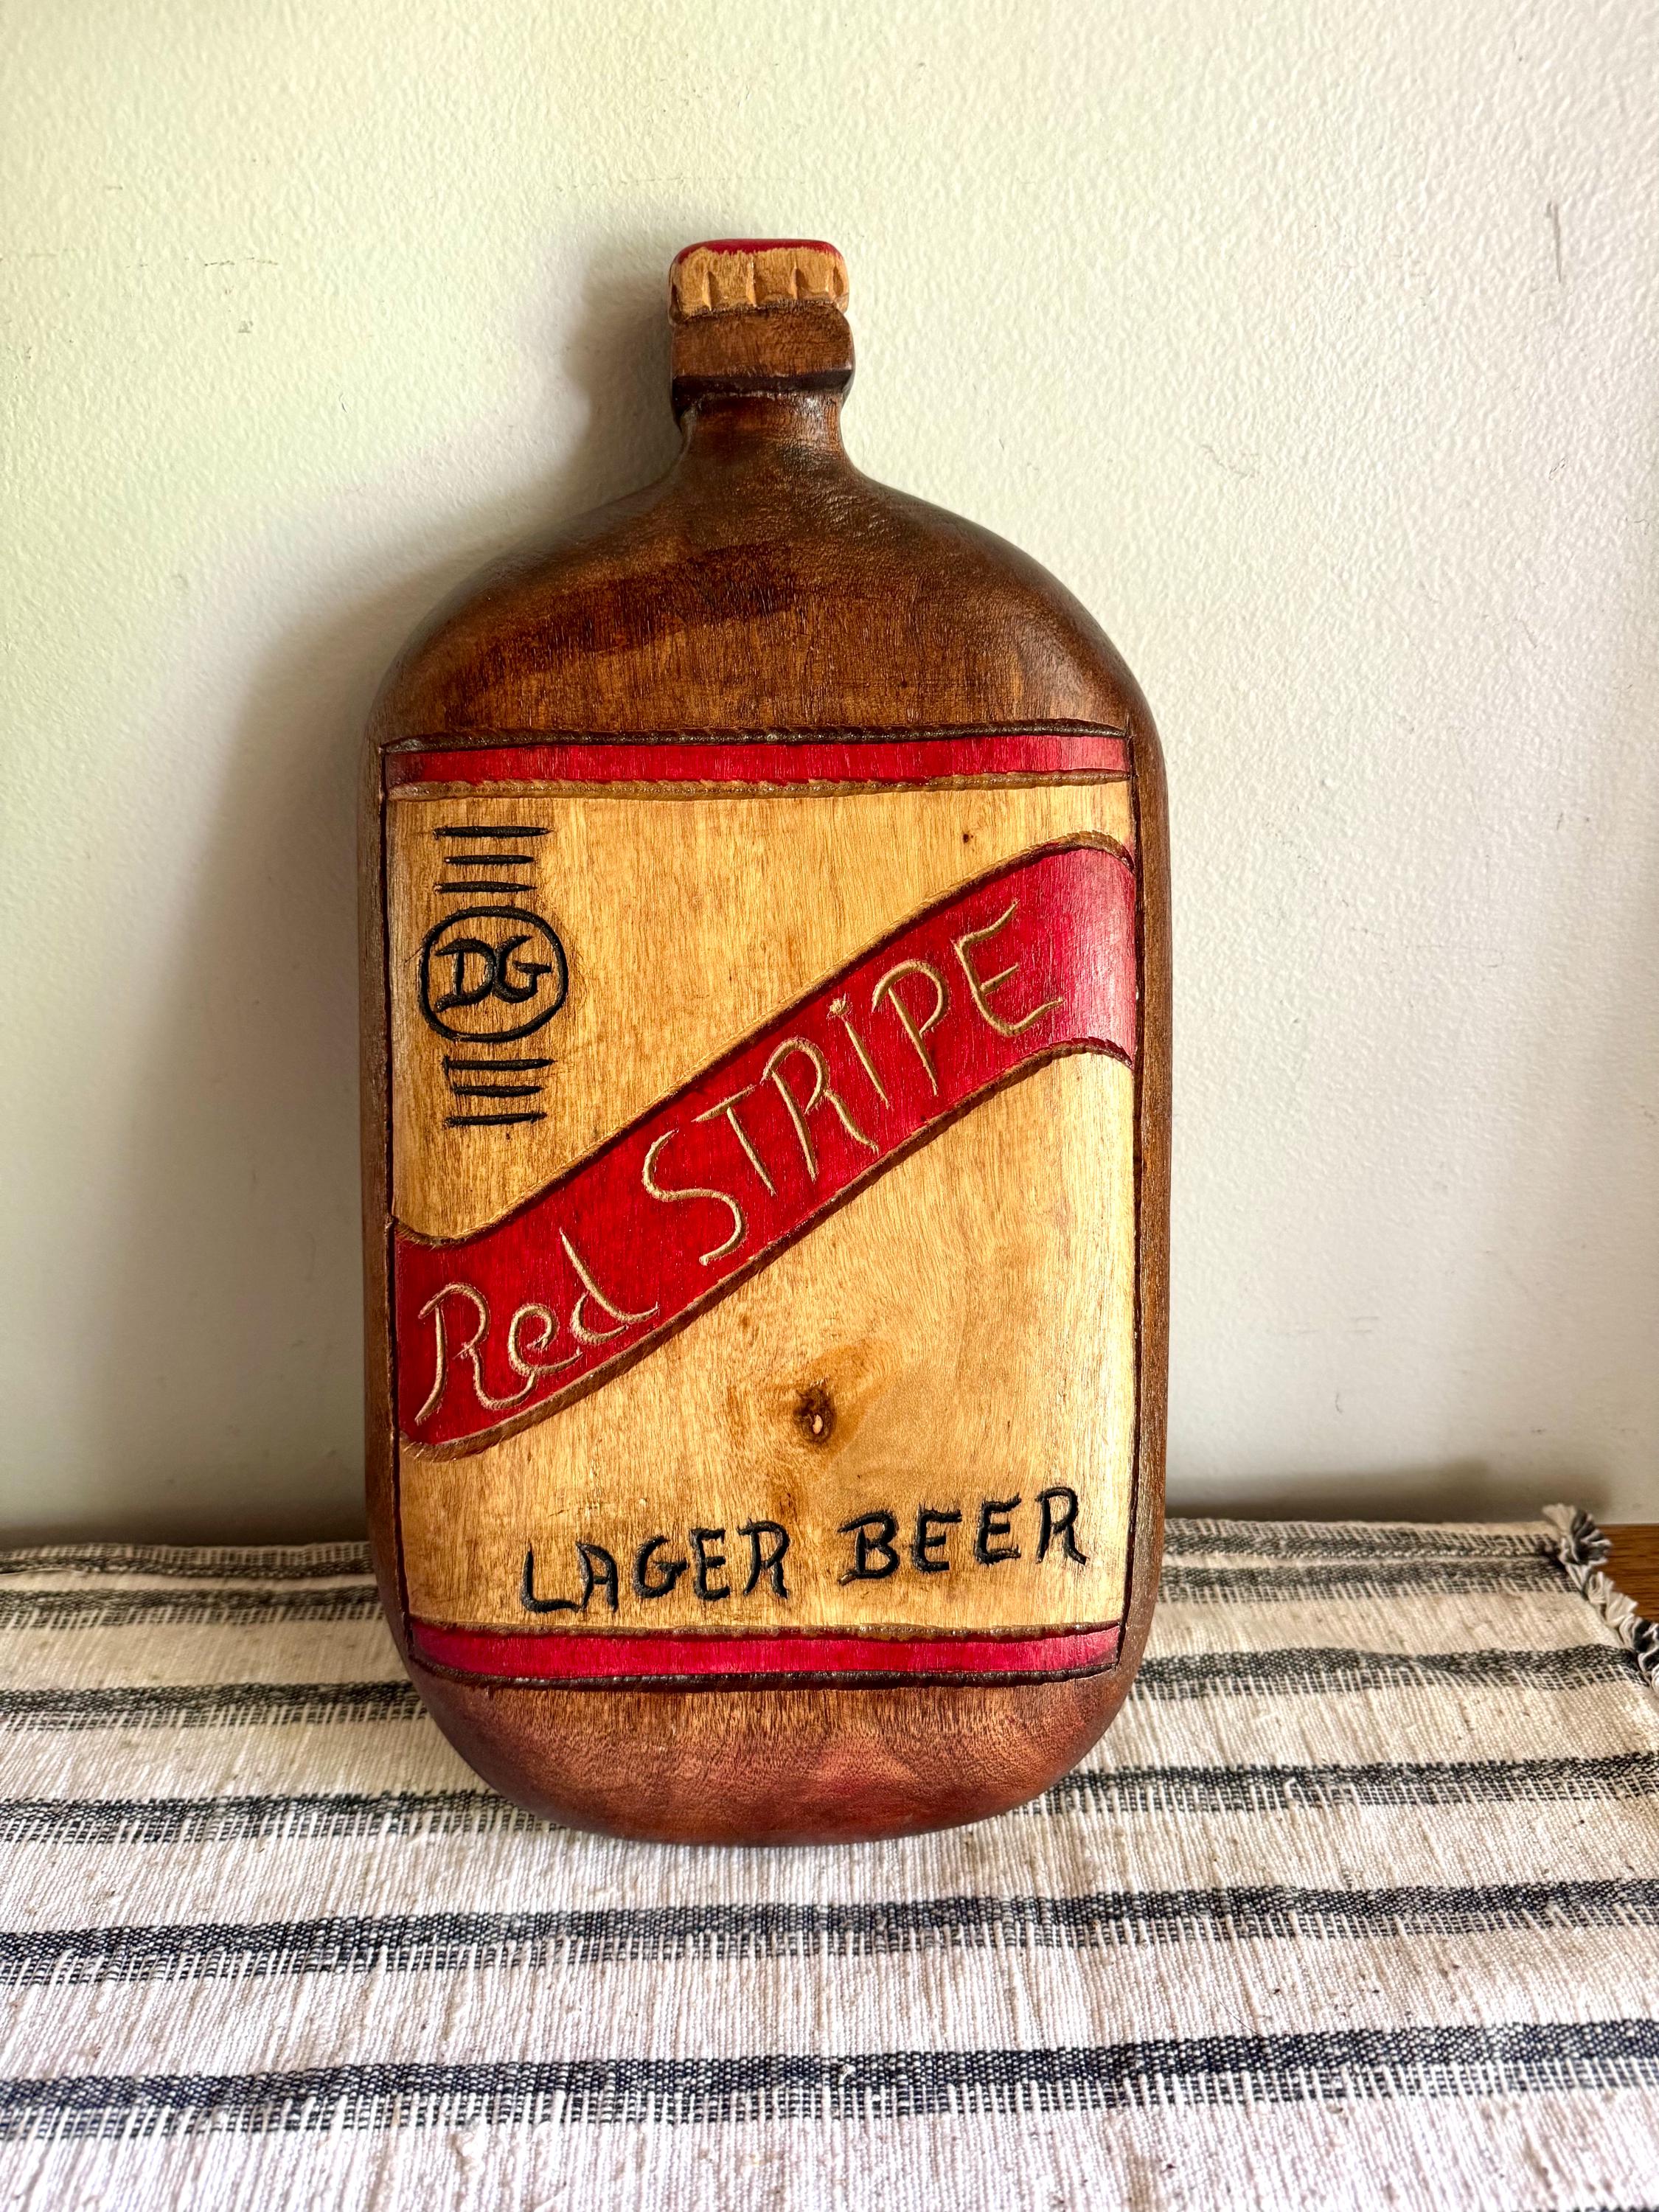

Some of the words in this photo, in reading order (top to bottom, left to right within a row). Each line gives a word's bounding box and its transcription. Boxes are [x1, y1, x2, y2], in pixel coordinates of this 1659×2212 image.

[435, 935, 552, 1011] DG
[414, 1228, 660, 1425] Red
[520, 1520, 792, 1613] LAGER
[837, 1486, 1088, 1585] BEER
